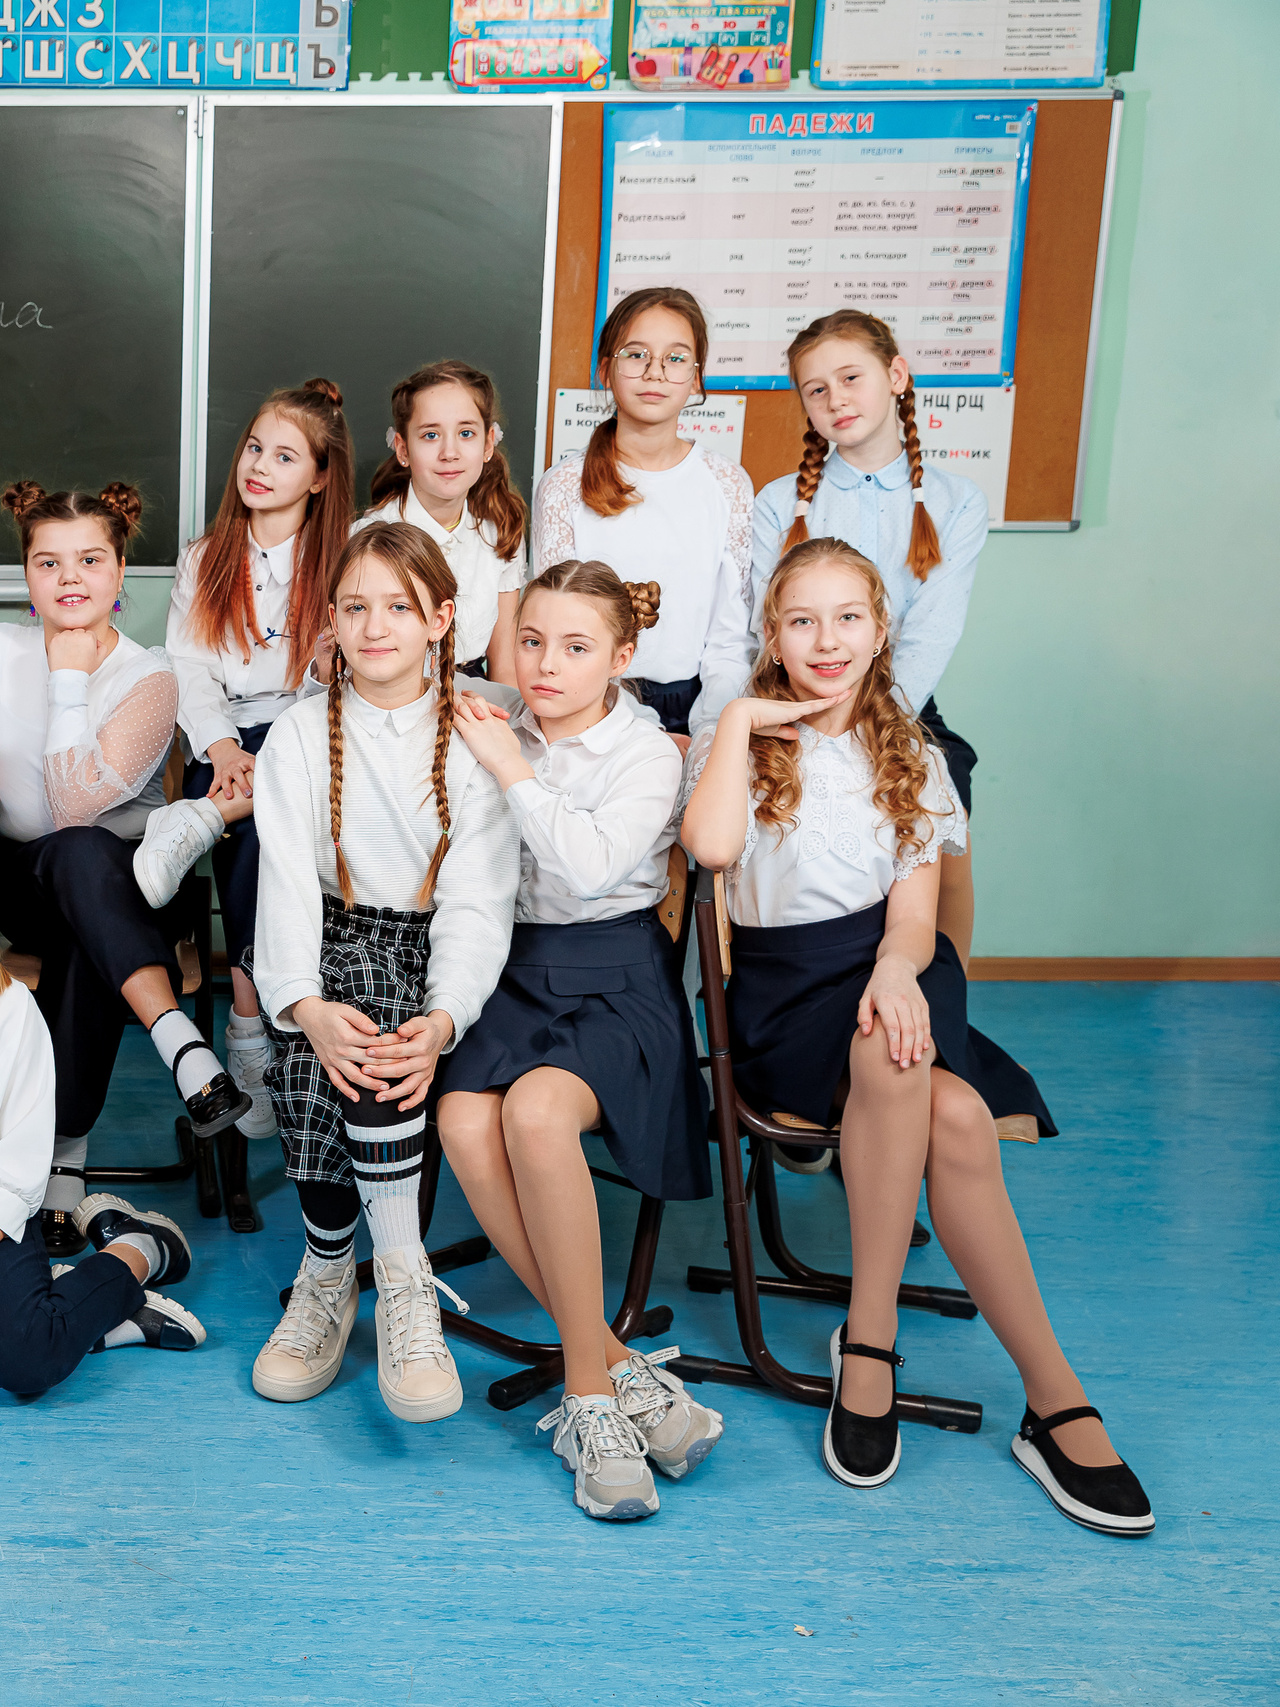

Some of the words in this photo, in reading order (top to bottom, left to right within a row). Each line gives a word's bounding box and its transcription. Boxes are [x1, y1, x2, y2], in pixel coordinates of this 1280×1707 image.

[23, 0, 65, 27] Ж
[24, 40, 65, 79] Ш
[75, 40, 104, 80] С
[120, 40, 152, 80] Х
[167, 41, 201, 85] Ц
[215, 42, 242, 80] Ч
[255, 42, 297, 85] Щ
[307, 43, 336, 79] Ъ
[749, 112, 875, 137] ПАДЕЖИ
[619, 174, 696, 184] Именительный
[617, 212, 686, 223] Родительный
[615, 252, 671, 263] Дательный
[923, 393, 950, 410] нщ
[956, 393, 984, 412] рщ
[576, 419, 601, 431] кор
